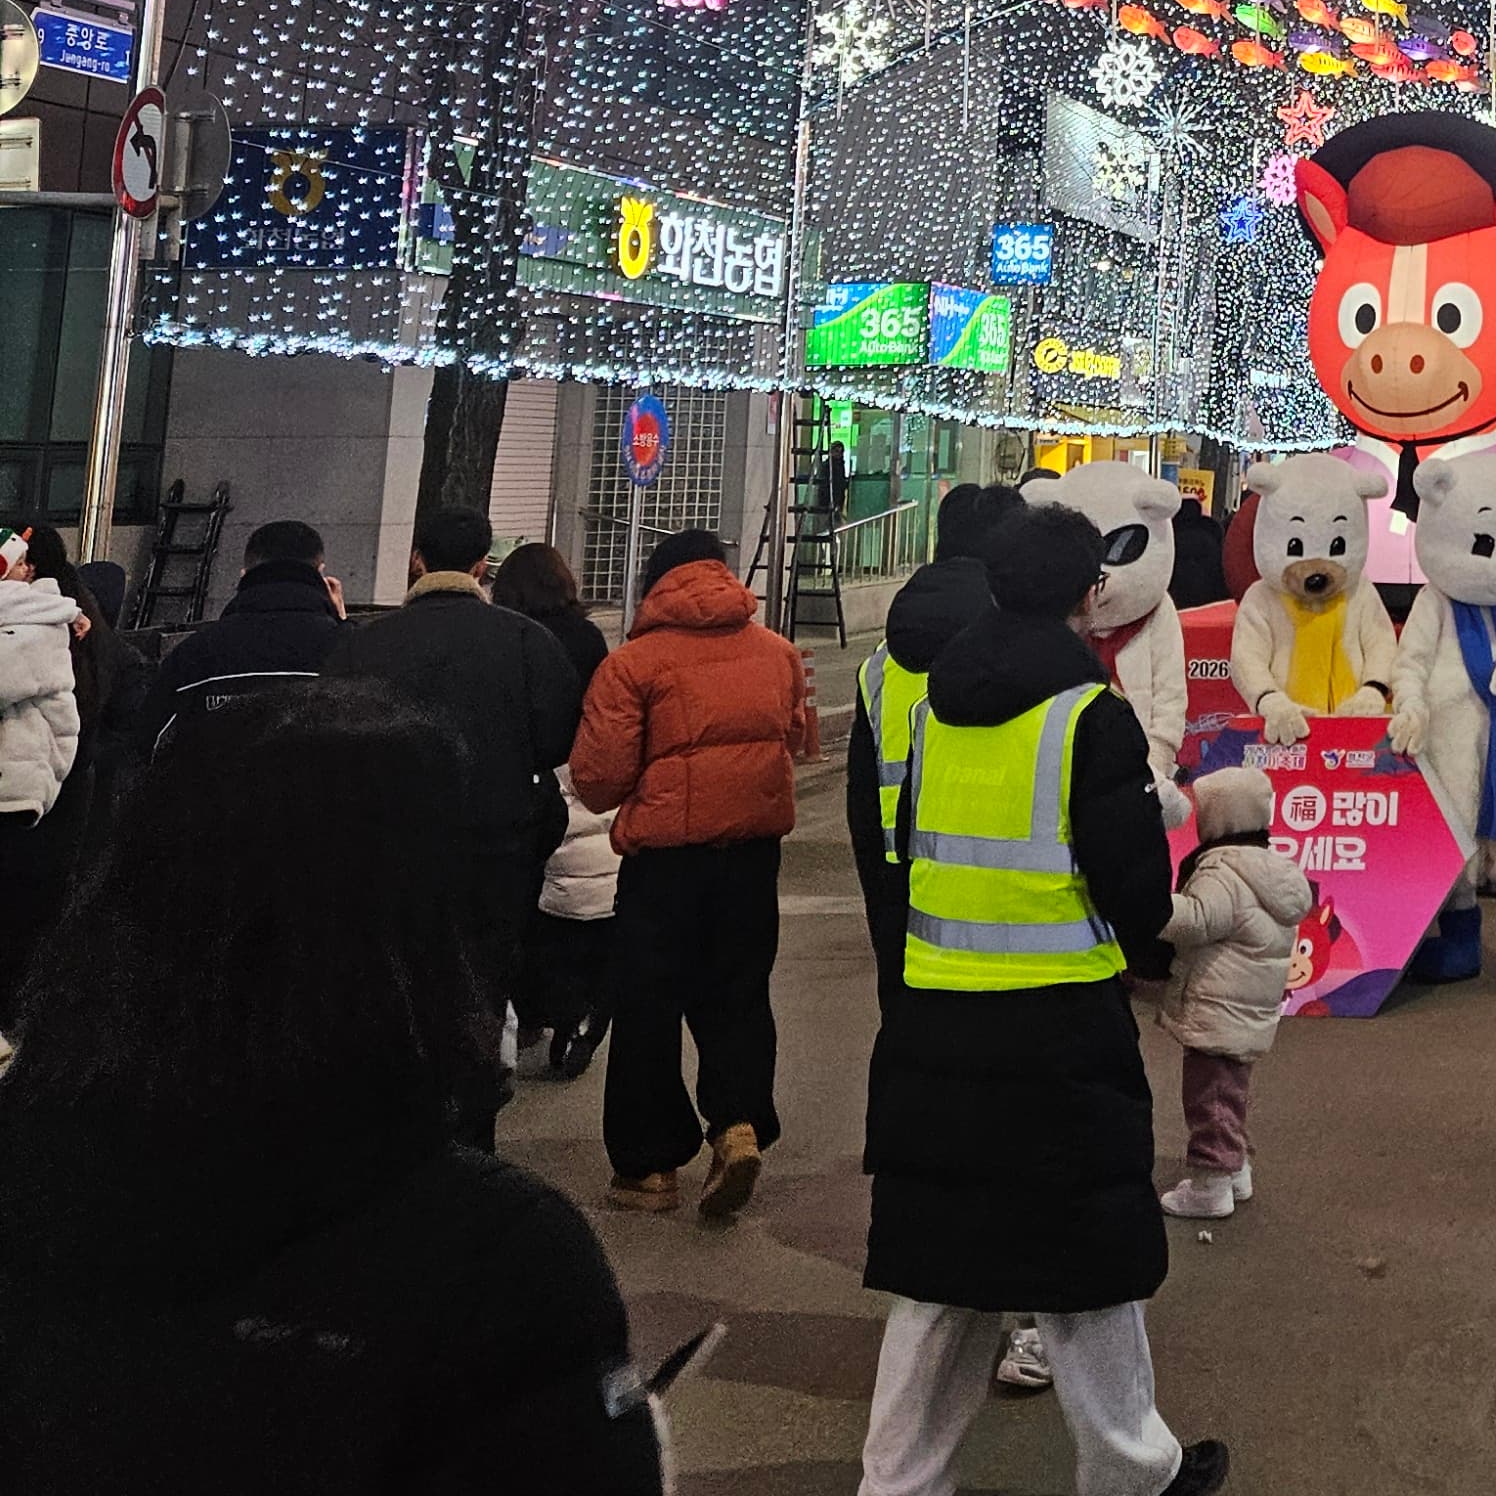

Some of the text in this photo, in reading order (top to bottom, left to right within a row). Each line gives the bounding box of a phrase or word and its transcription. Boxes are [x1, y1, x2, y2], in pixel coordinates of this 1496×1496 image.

[65, 23, 109, 51] 중앙로
[59, 49, 111, 72] Jungang-ro
[656, 211, 784, 298] 화천농협
[996, 234, 1051, 261] 365
[859, 306, 921, 338] 365
[1188, 658, 1230, 680] 2026
[1331, 791, 1399, 827] 많이
